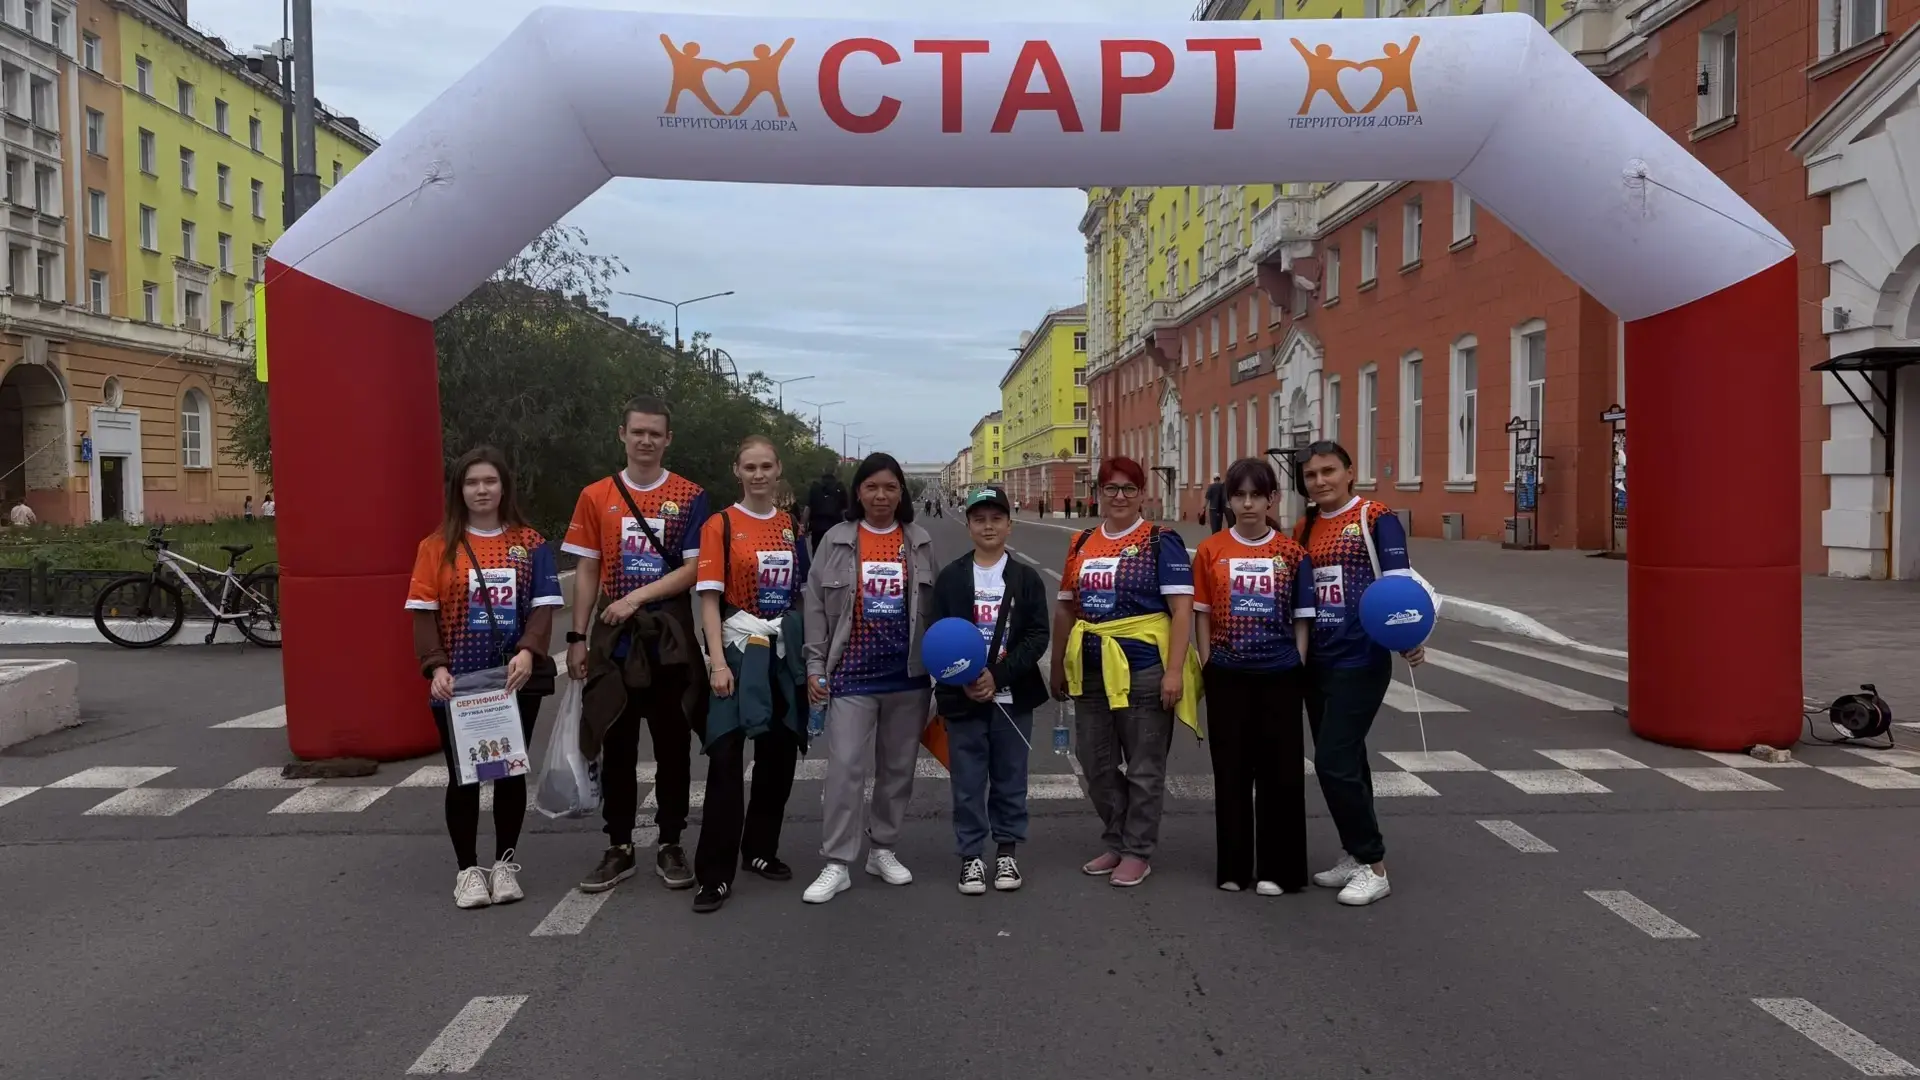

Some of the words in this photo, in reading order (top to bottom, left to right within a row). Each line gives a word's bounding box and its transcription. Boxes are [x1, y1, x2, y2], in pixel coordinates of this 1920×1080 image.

[818, 37, 1262, 133] СТАРТ
[657, 115, 748, 130] ТЕРРИТОРИЯ
[751, 117, 798, 132] ДОБРА
[1288, 115, 1376, 130] ТЕРРИТОРИЯ
[1378, 114, 1423, 128] ДОБРА
[760, 568, 791, 587] 477
[1082, 572, 1113, 590] 480
[1233, 575, 1272, 595] 479
[471, 585, 514, 606] 482
[865, 578, 901, 597] 475
[1316, 584, 1342, 606] 76
[456, 692, 510, 708] СЕРТИФИКАТ
